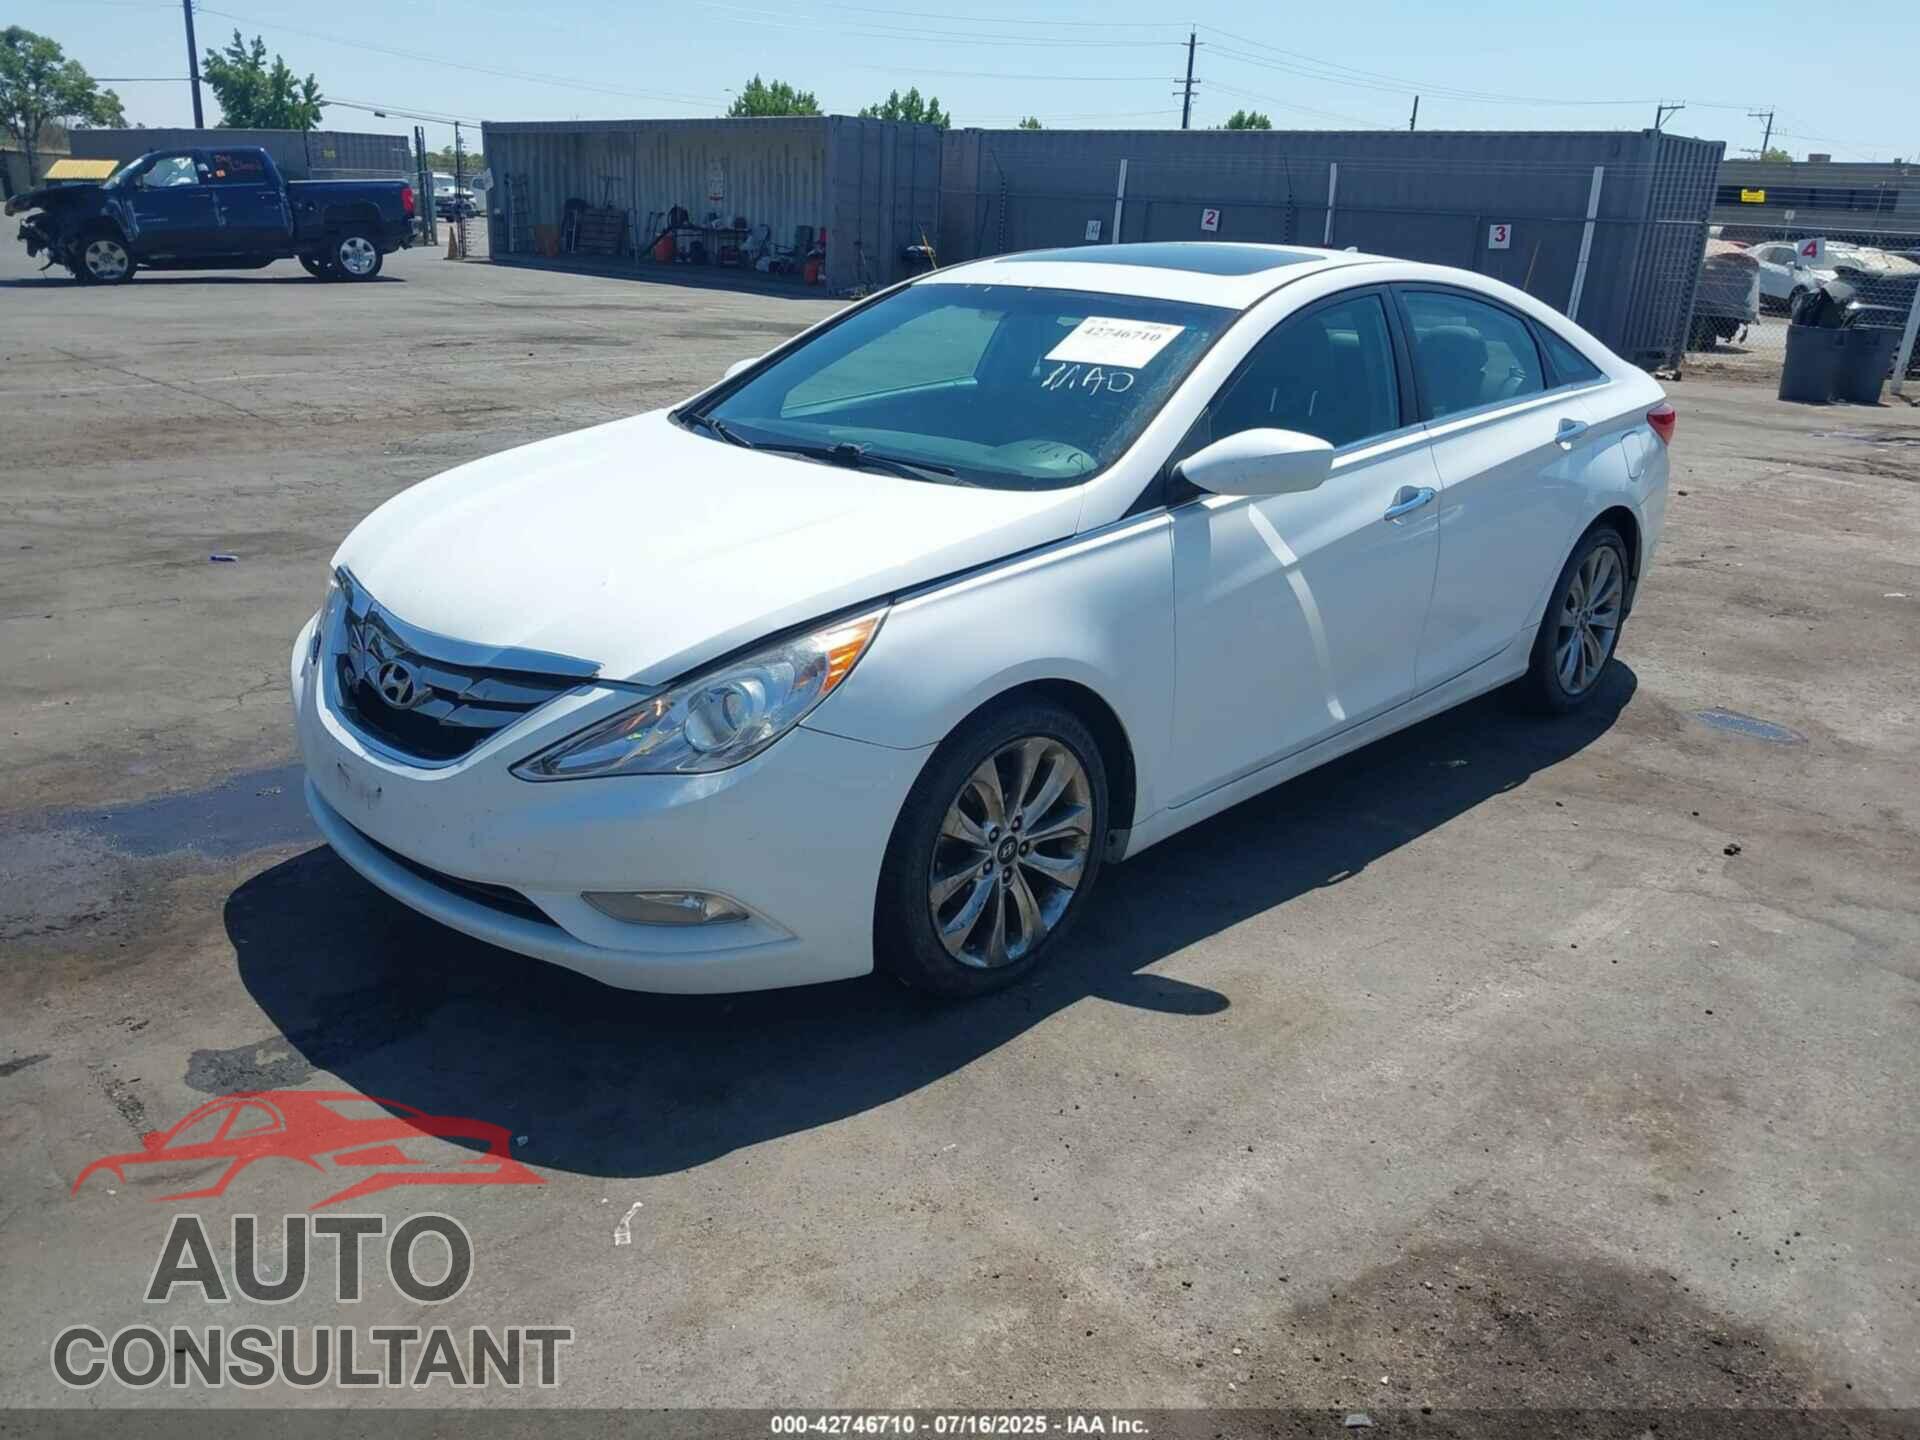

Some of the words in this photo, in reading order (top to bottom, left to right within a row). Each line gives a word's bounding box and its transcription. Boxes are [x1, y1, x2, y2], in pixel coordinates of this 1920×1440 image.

[1206, 211, 1216, 225] 2
[1495, 226, 1506, 242] 3
[1801, 240, 1817, 258] 4
[1084, 327, 1162, 341] 42746710
